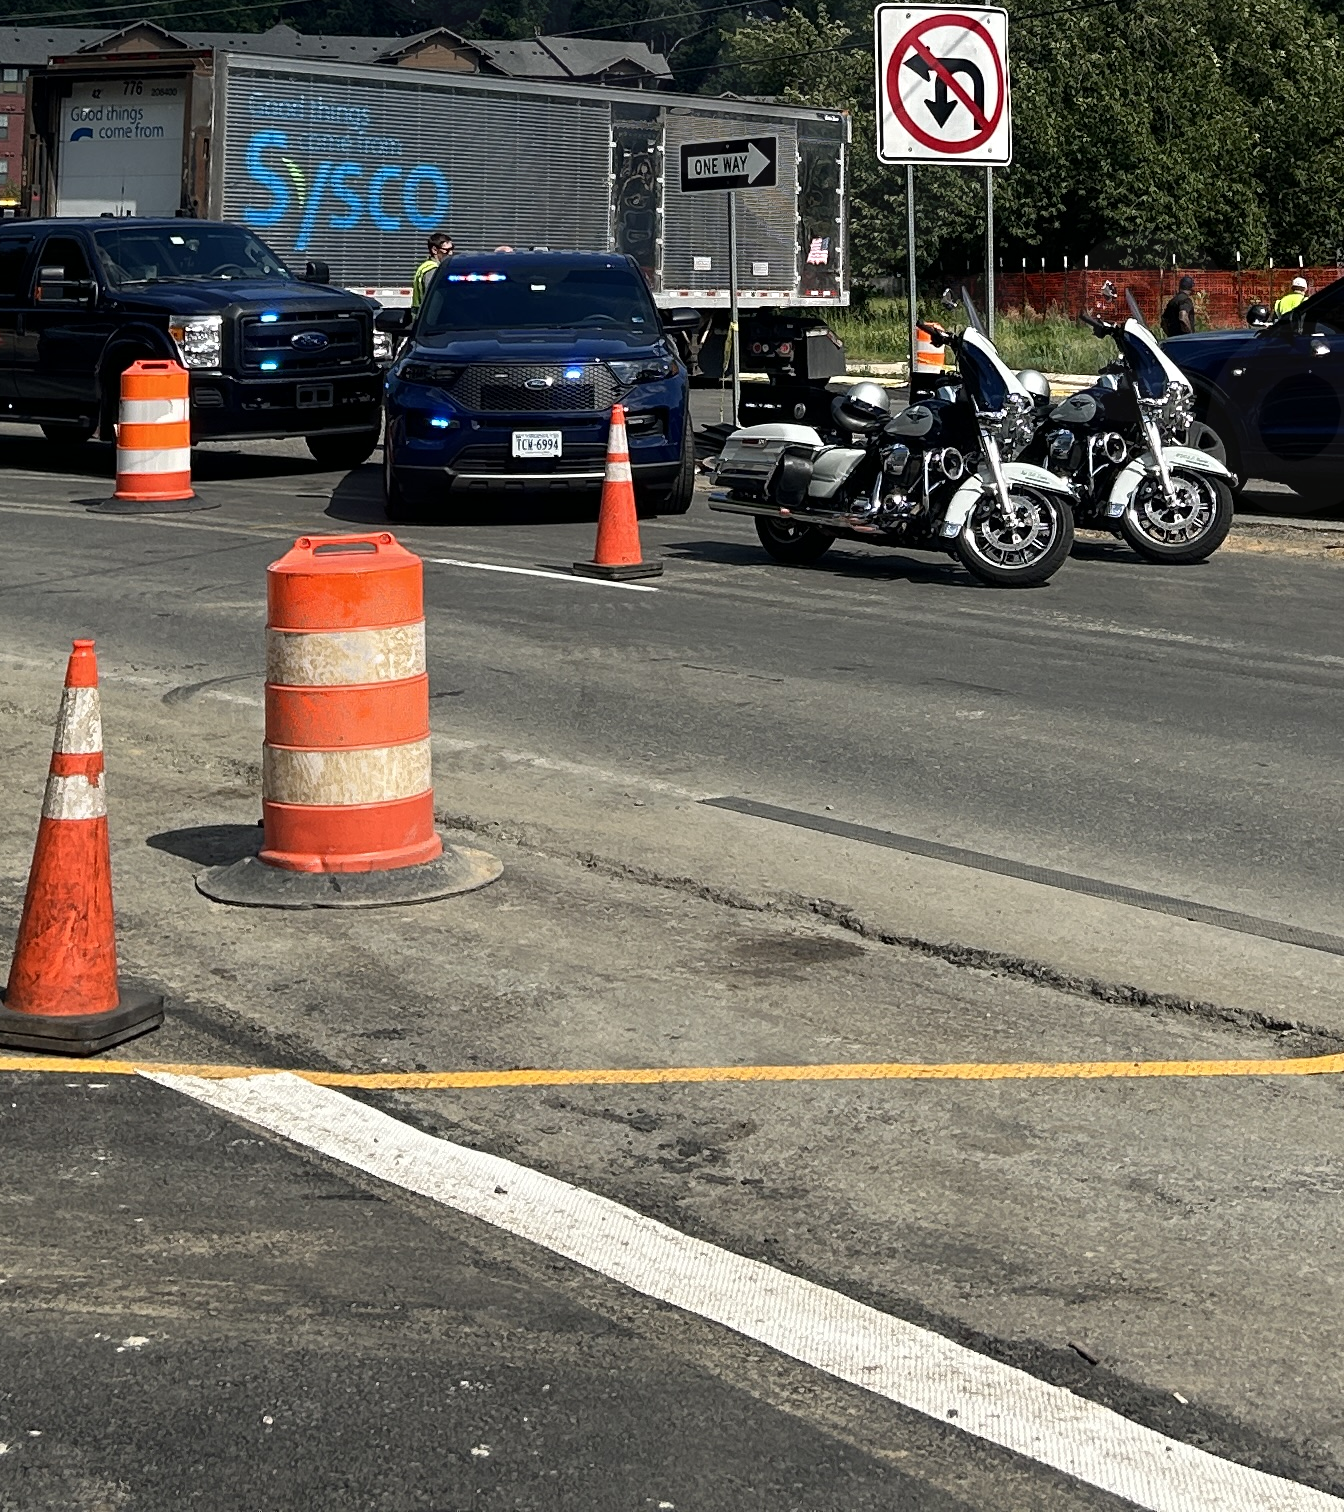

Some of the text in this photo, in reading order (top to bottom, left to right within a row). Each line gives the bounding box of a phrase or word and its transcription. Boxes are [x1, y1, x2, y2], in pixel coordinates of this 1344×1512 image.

[123, 81, 143, 96] 776
[70, 105, 144, 125] Good things
[98, 122, 164, 139] come from
[694, 155, 749, 176] ONE WAY
[243, 129, 449, 252] Sysco
